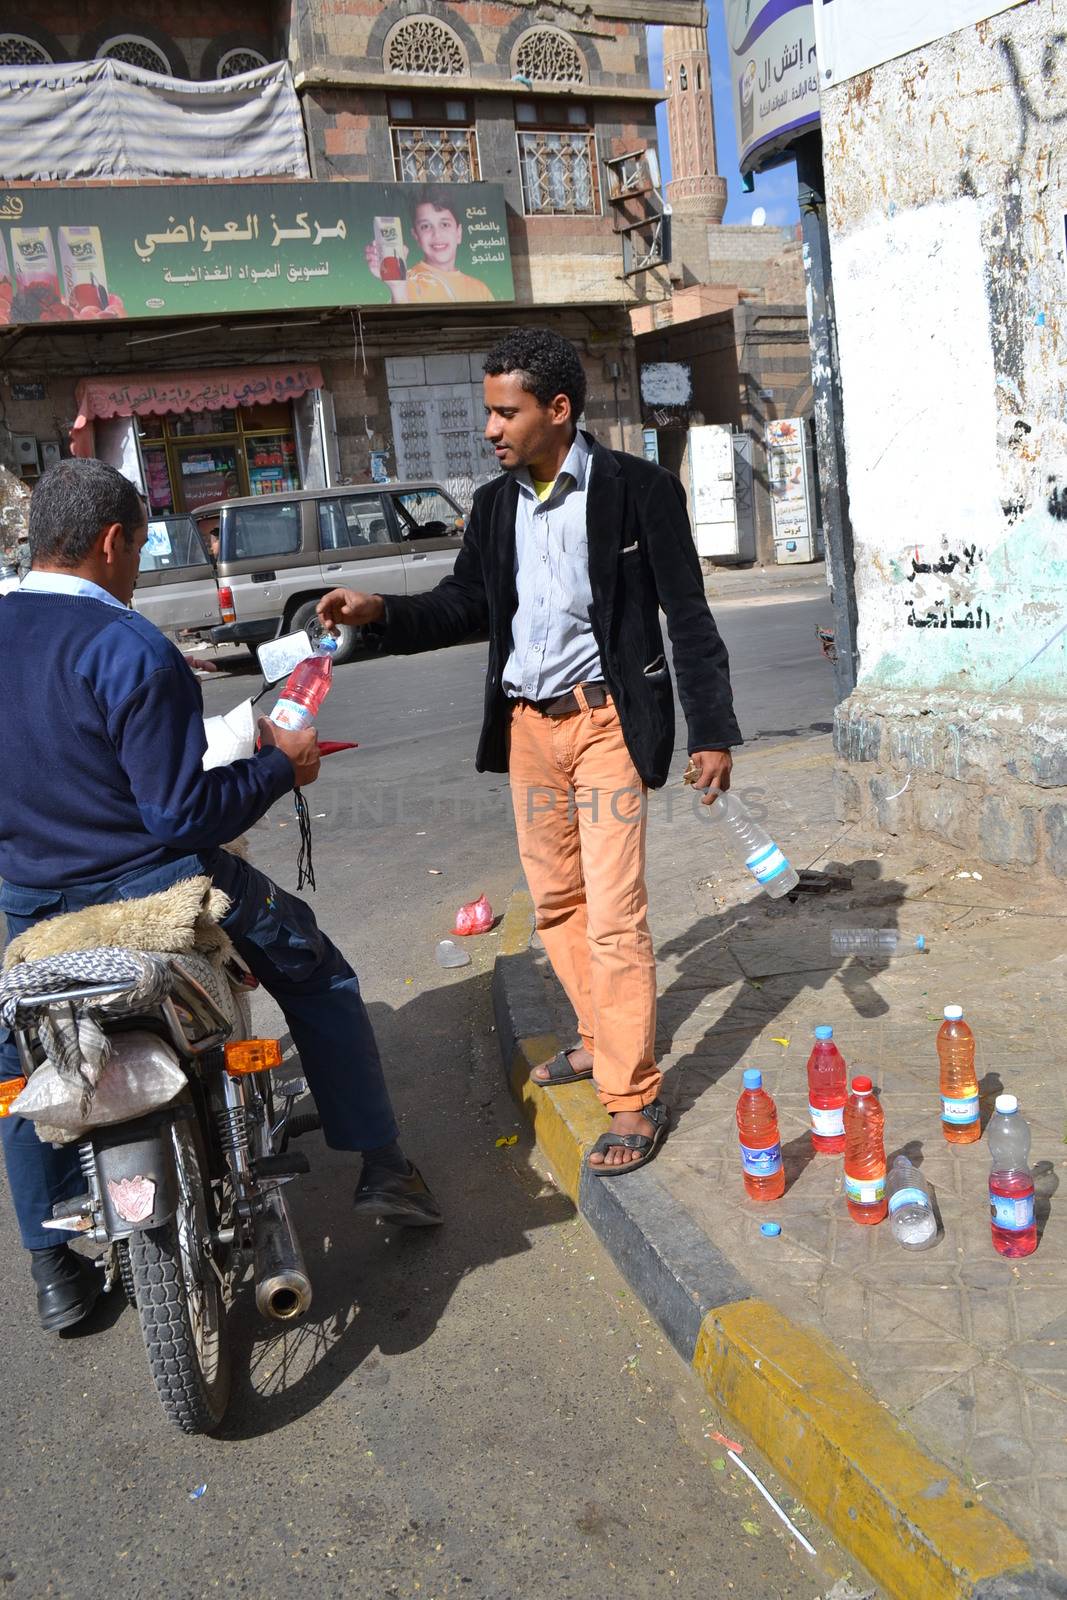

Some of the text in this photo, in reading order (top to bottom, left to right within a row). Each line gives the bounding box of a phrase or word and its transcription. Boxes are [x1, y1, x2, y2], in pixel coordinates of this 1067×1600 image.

[465, 206, 488, 219] تمتع
[134, 212, 347, 263] مركز العواضي
[468, 221, 500, 235] بالطعم
[469, 237, 506, 252] الطبيعي
[471, 252, 505, 265] للمانجو
[163, 261, 329, 287] لتسويق المواد الغذائية
[233, 371, 313, 402] العواضي
[904, 598, 991, 629] الفاتحة
